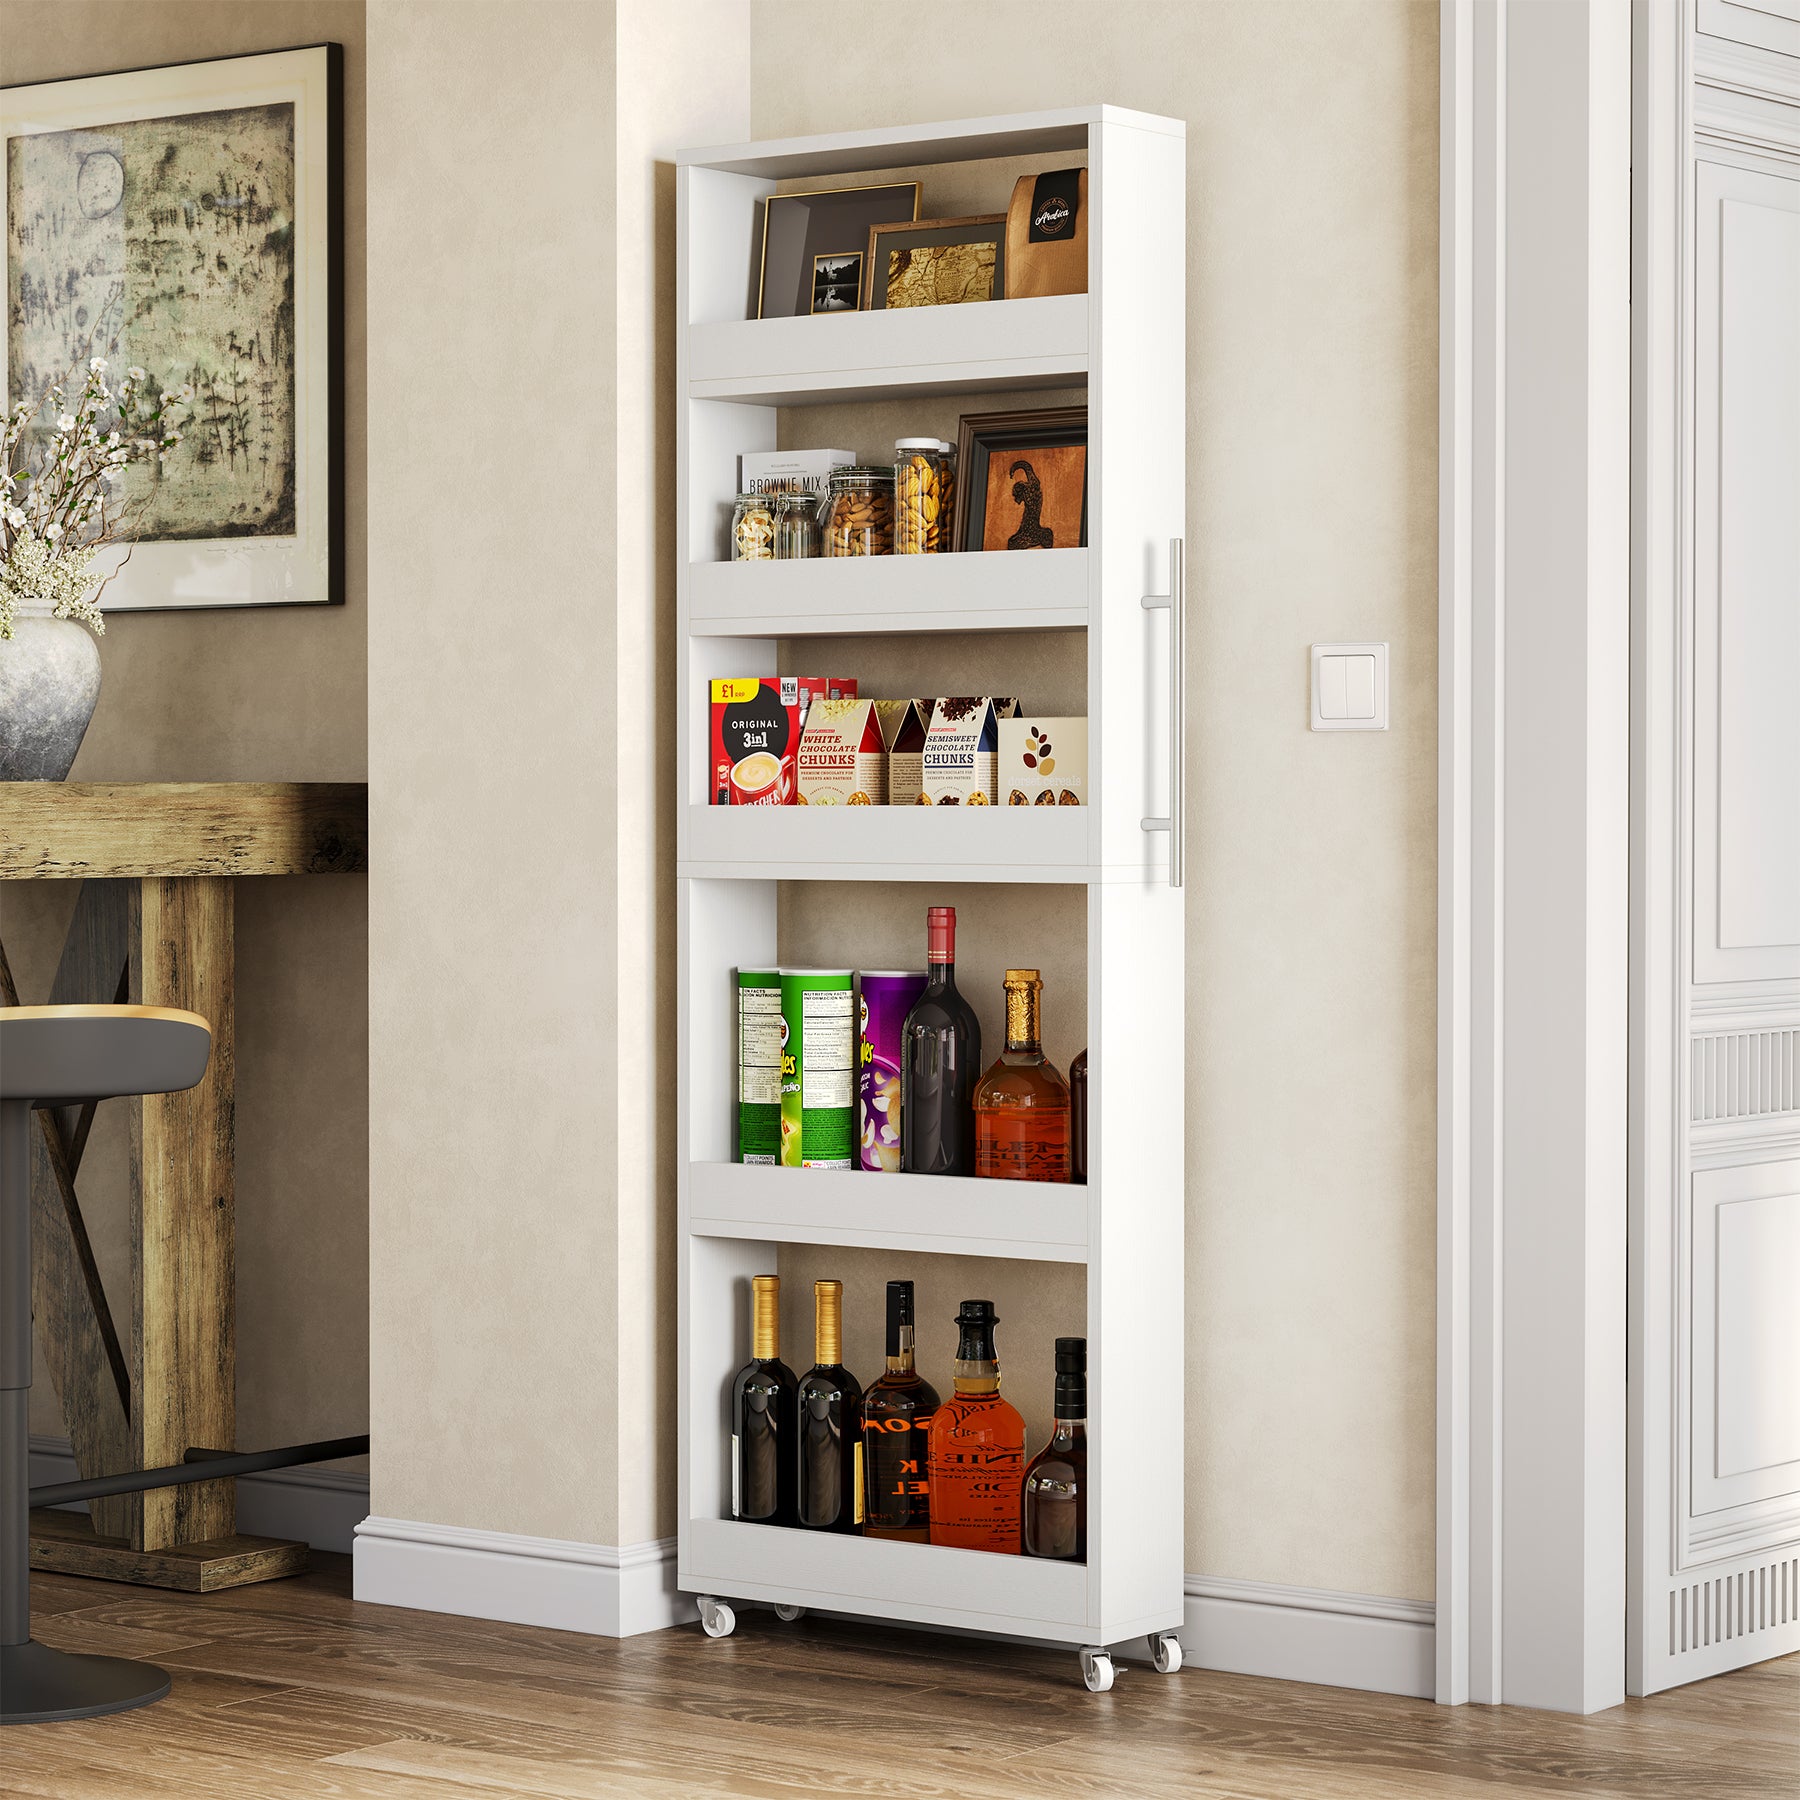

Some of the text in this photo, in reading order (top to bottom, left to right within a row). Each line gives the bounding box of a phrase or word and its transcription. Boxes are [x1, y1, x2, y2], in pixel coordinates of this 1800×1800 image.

[1035, 209, 1070, 226] Arabica
[749, 476, 821, 494] BROWNIE MIX
[722, 684, 734, 698] £1
[781, 683, 797, 693] NEW
[731, 720, 779, 730] ORIGINAL
[743, 731, 768, 748] 3in1
[803, 735, 843, 744] WHITE
[927, 735, 978, 743] SEMISWEET
[800, 745, 857, 753] CHOCOLATE
[925, 744, 976, 752] CHOCOLATE
[799, 754, 855, 765] CHUNKS
[924, 753, 974, 764] CHUNKS
